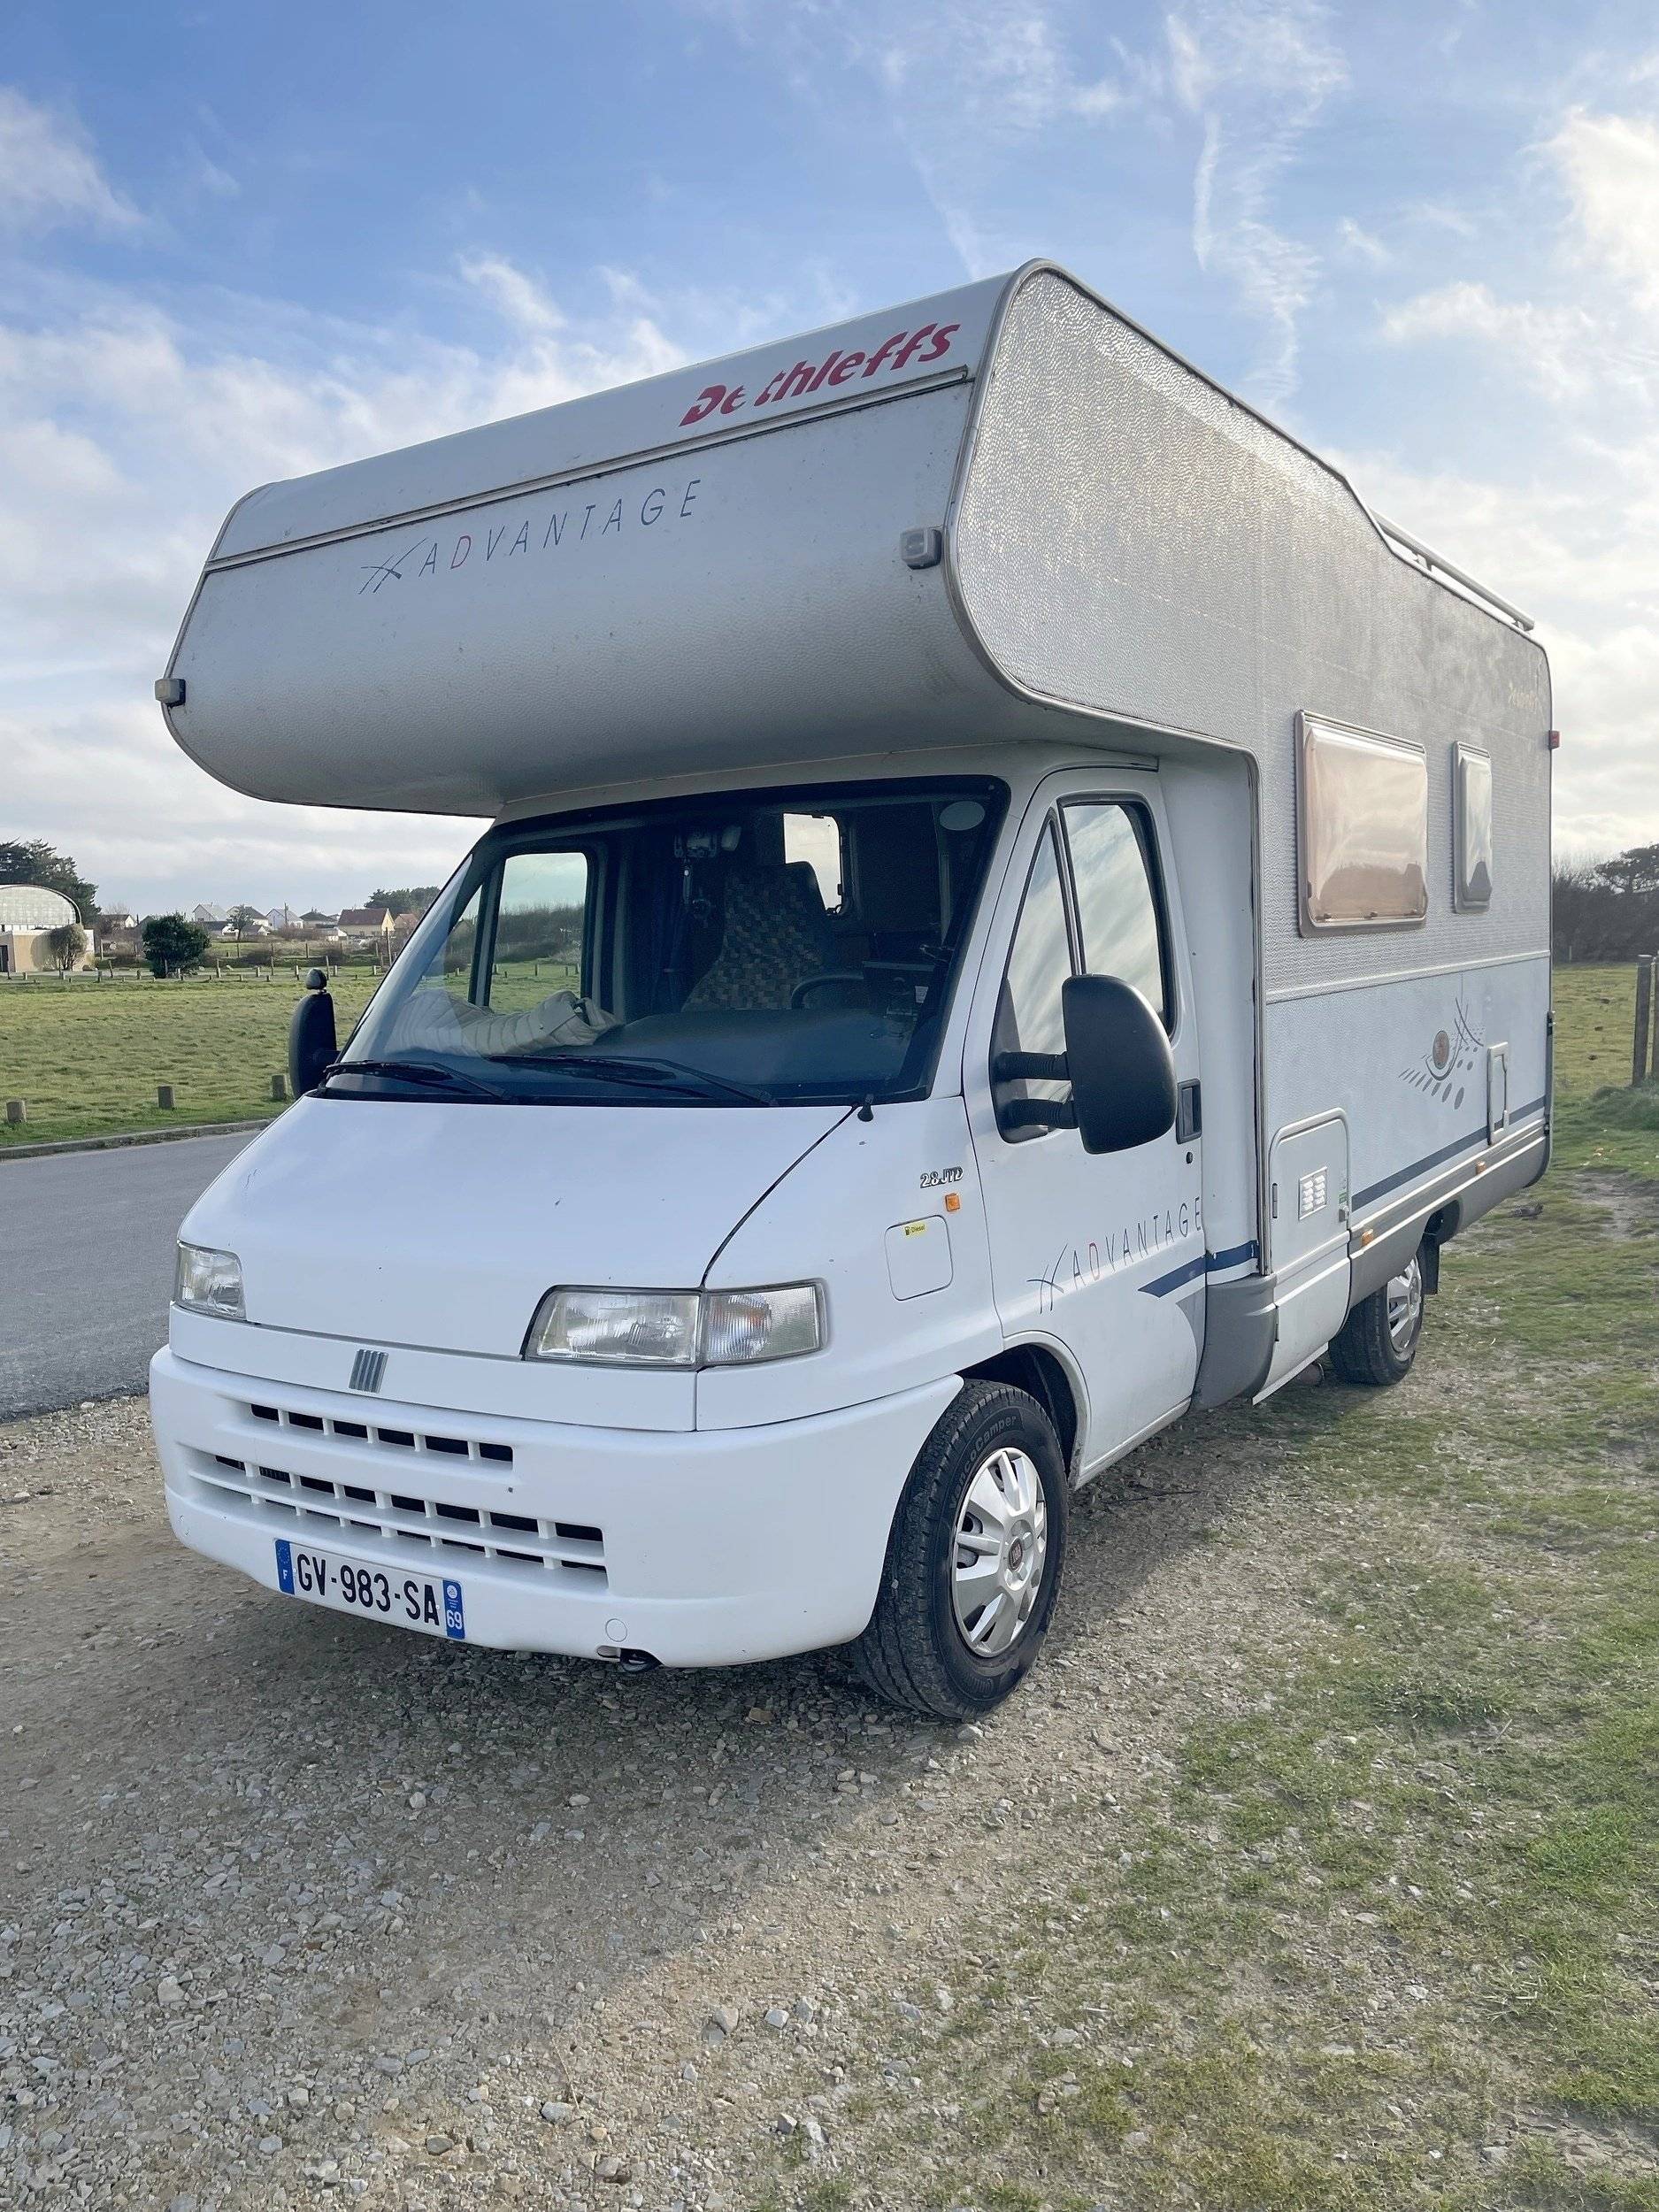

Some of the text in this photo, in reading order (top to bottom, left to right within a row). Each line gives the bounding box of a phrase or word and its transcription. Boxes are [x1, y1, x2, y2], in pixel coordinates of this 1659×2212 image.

[419, 479, 702, 578] ADVANTAGE
[1073, 1196, 1202, 1291] ADVANTAGE
[282, 1569, 288, 1580] F
[296, 1553, 440, 1626] GV-983-SA
[446, 1609, 461, 1630] 69
